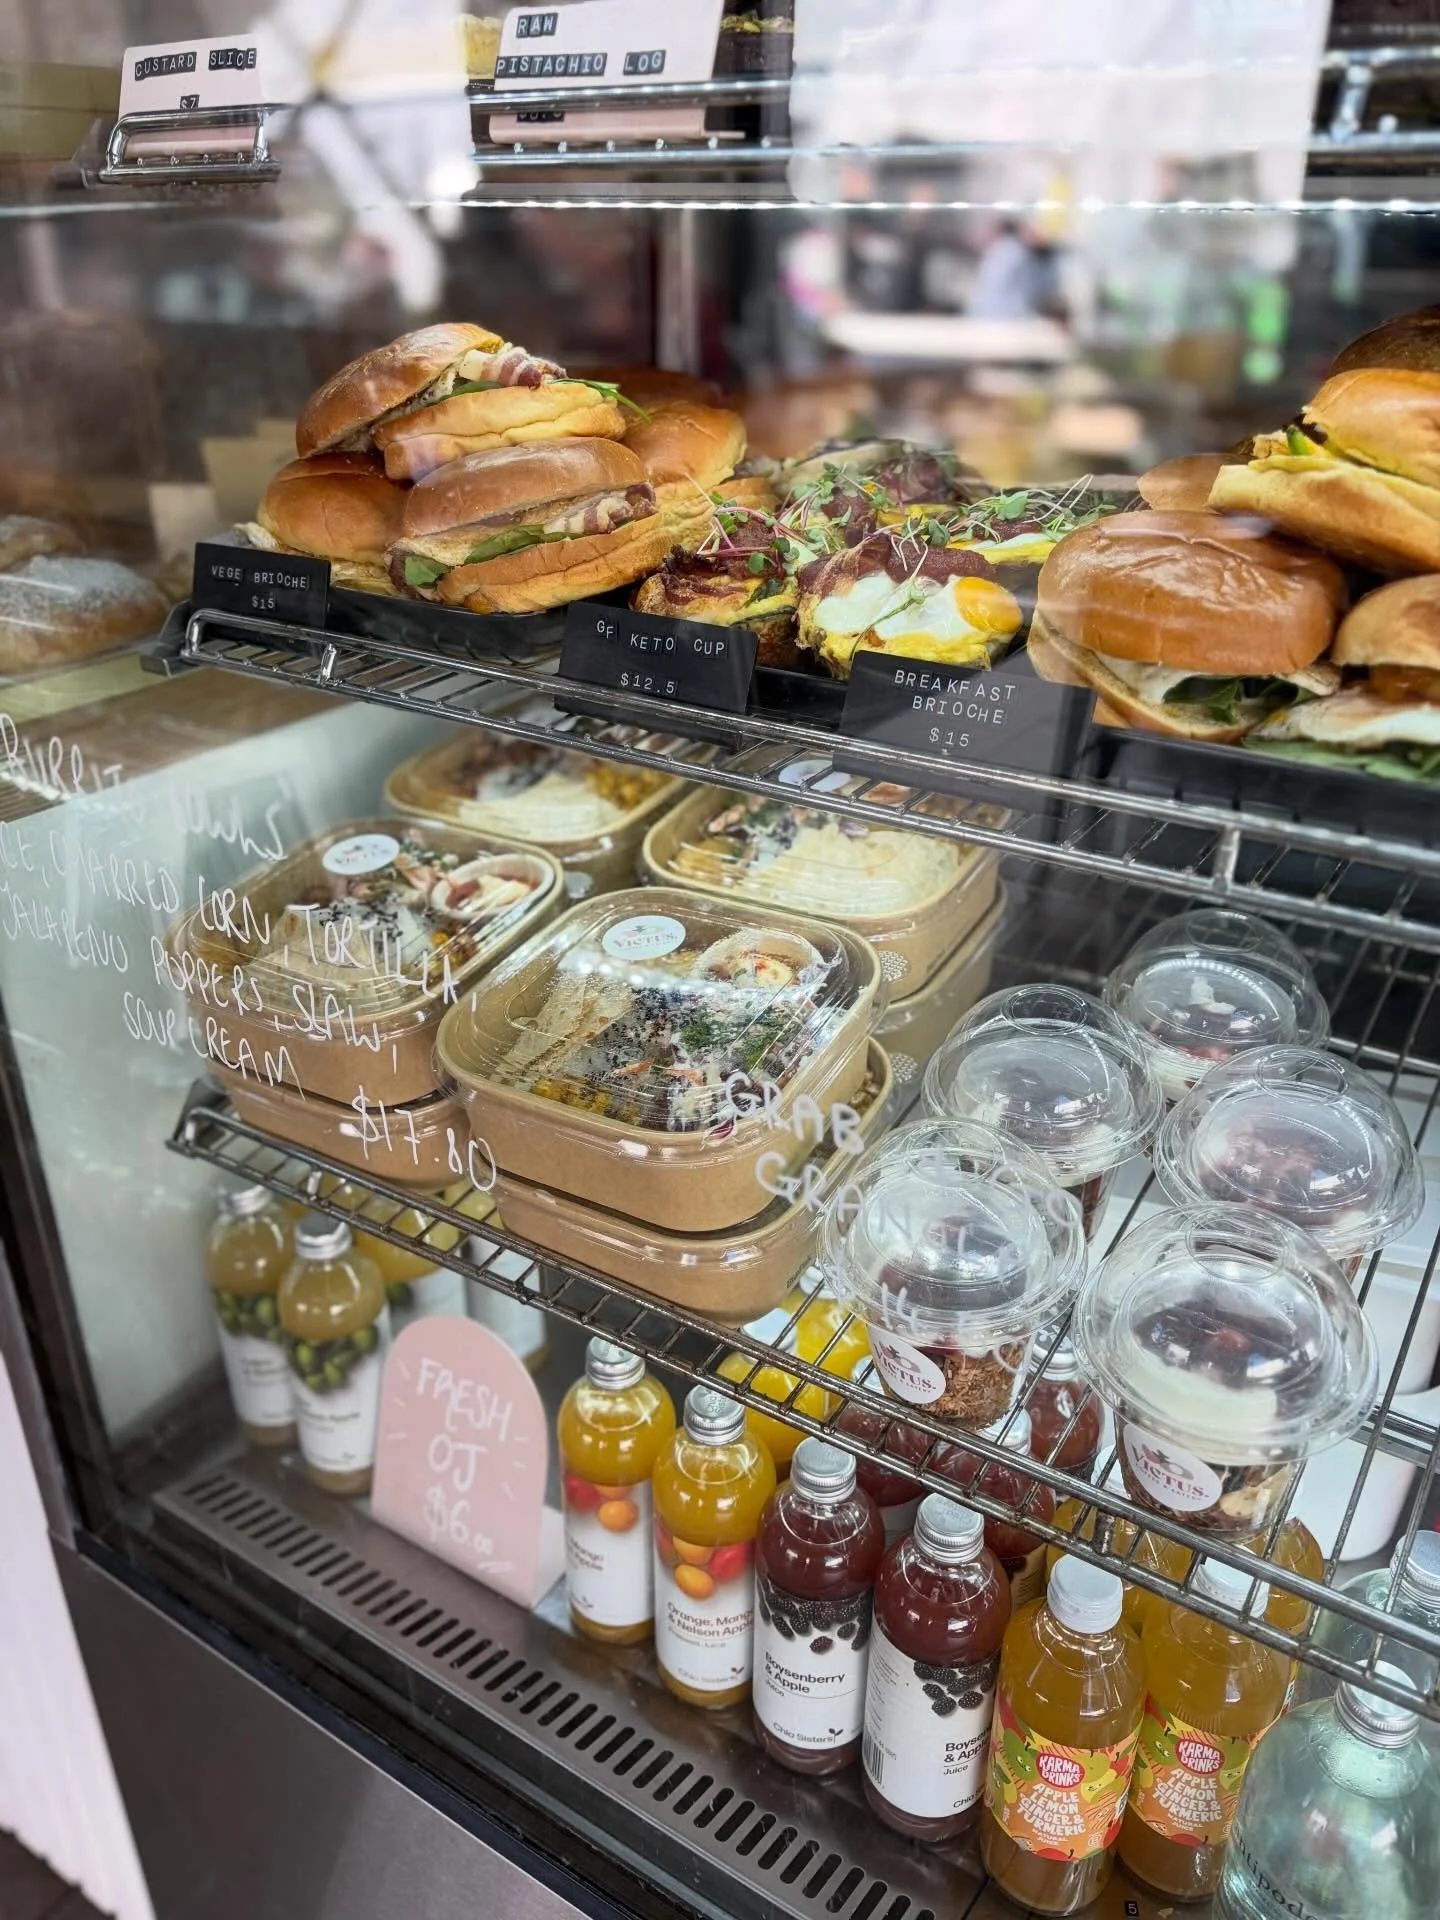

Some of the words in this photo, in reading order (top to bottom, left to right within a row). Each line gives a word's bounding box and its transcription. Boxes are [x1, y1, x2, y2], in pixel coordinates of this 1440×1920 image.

[517, 15, 554, 35] RAW
[135, 54, 195, 77] CUSTARD
[210, 51, 255, 66] SLICE
[496, 54, 604, 75] PISTACHIO
[625, 51, 663, 71] LOG
[211, 565, 241, 580] VEGE
[254, 572, 307, 589] BRIOCHE
[251, 595, 275, 609] $15
[596, 620, 614, 639] GF
[630, 633, 675, 651] KETO
[693, 638, 725, 655] CUP
[620, 672, 675, 695] $12.5
[894, 669, 1016, 702] BREAKFAST
[912, 695, 1004, 725] BRIOCHE
[929, 727, 969, 747] $15
[123, 991, 186, 1055] SOUR
[188, 1016, 306, 1101] CREAM
[725, 1070, 865, 1155] GRAB
[351, 1085, 497, 1192] $17.80
[415, 1356, 515, 1442] FRESH
[426, 1432, 489, 1493] OJ
[677, 1618, 721, 1638] Nelson
[765, 1651, 845, 1684] Boysenberry
[765, 1663, 773, 1675] &
[774, 1673, 811, 1693] Apple
[773, 1722, 794, 1738] Chia
[944, 1752, 954, 1763] &
[1178, 1741, 1221, 1761] KARMA
[944, 1764, 969, 1776] Juice
[1039, 1755, 1081, 1774] KARMA
[1180, 1754, 1221, 1773] DRINKS
[1041, 1768, 1081, 1787] DRINKS
[1166, 1777, 1217, 1801] LEMON
[1170, 1768, 1218, 1789] APPLE
[953, 1794, 975, 1809] Chia
[1029, 1792, 1079, 1814] LEMON
[1032, 1783, 1080, 1803] APPLE
[1157, 1782, 1209, 1812] GINGER
[1020, 1798, 1071, 1826] GINGER
[1152, 1789, 1222, 1822] TURMERIC
[1017, 1803, 1086, 1837] TURMERIC
[1128, 1903, 1137, 1915] 5
